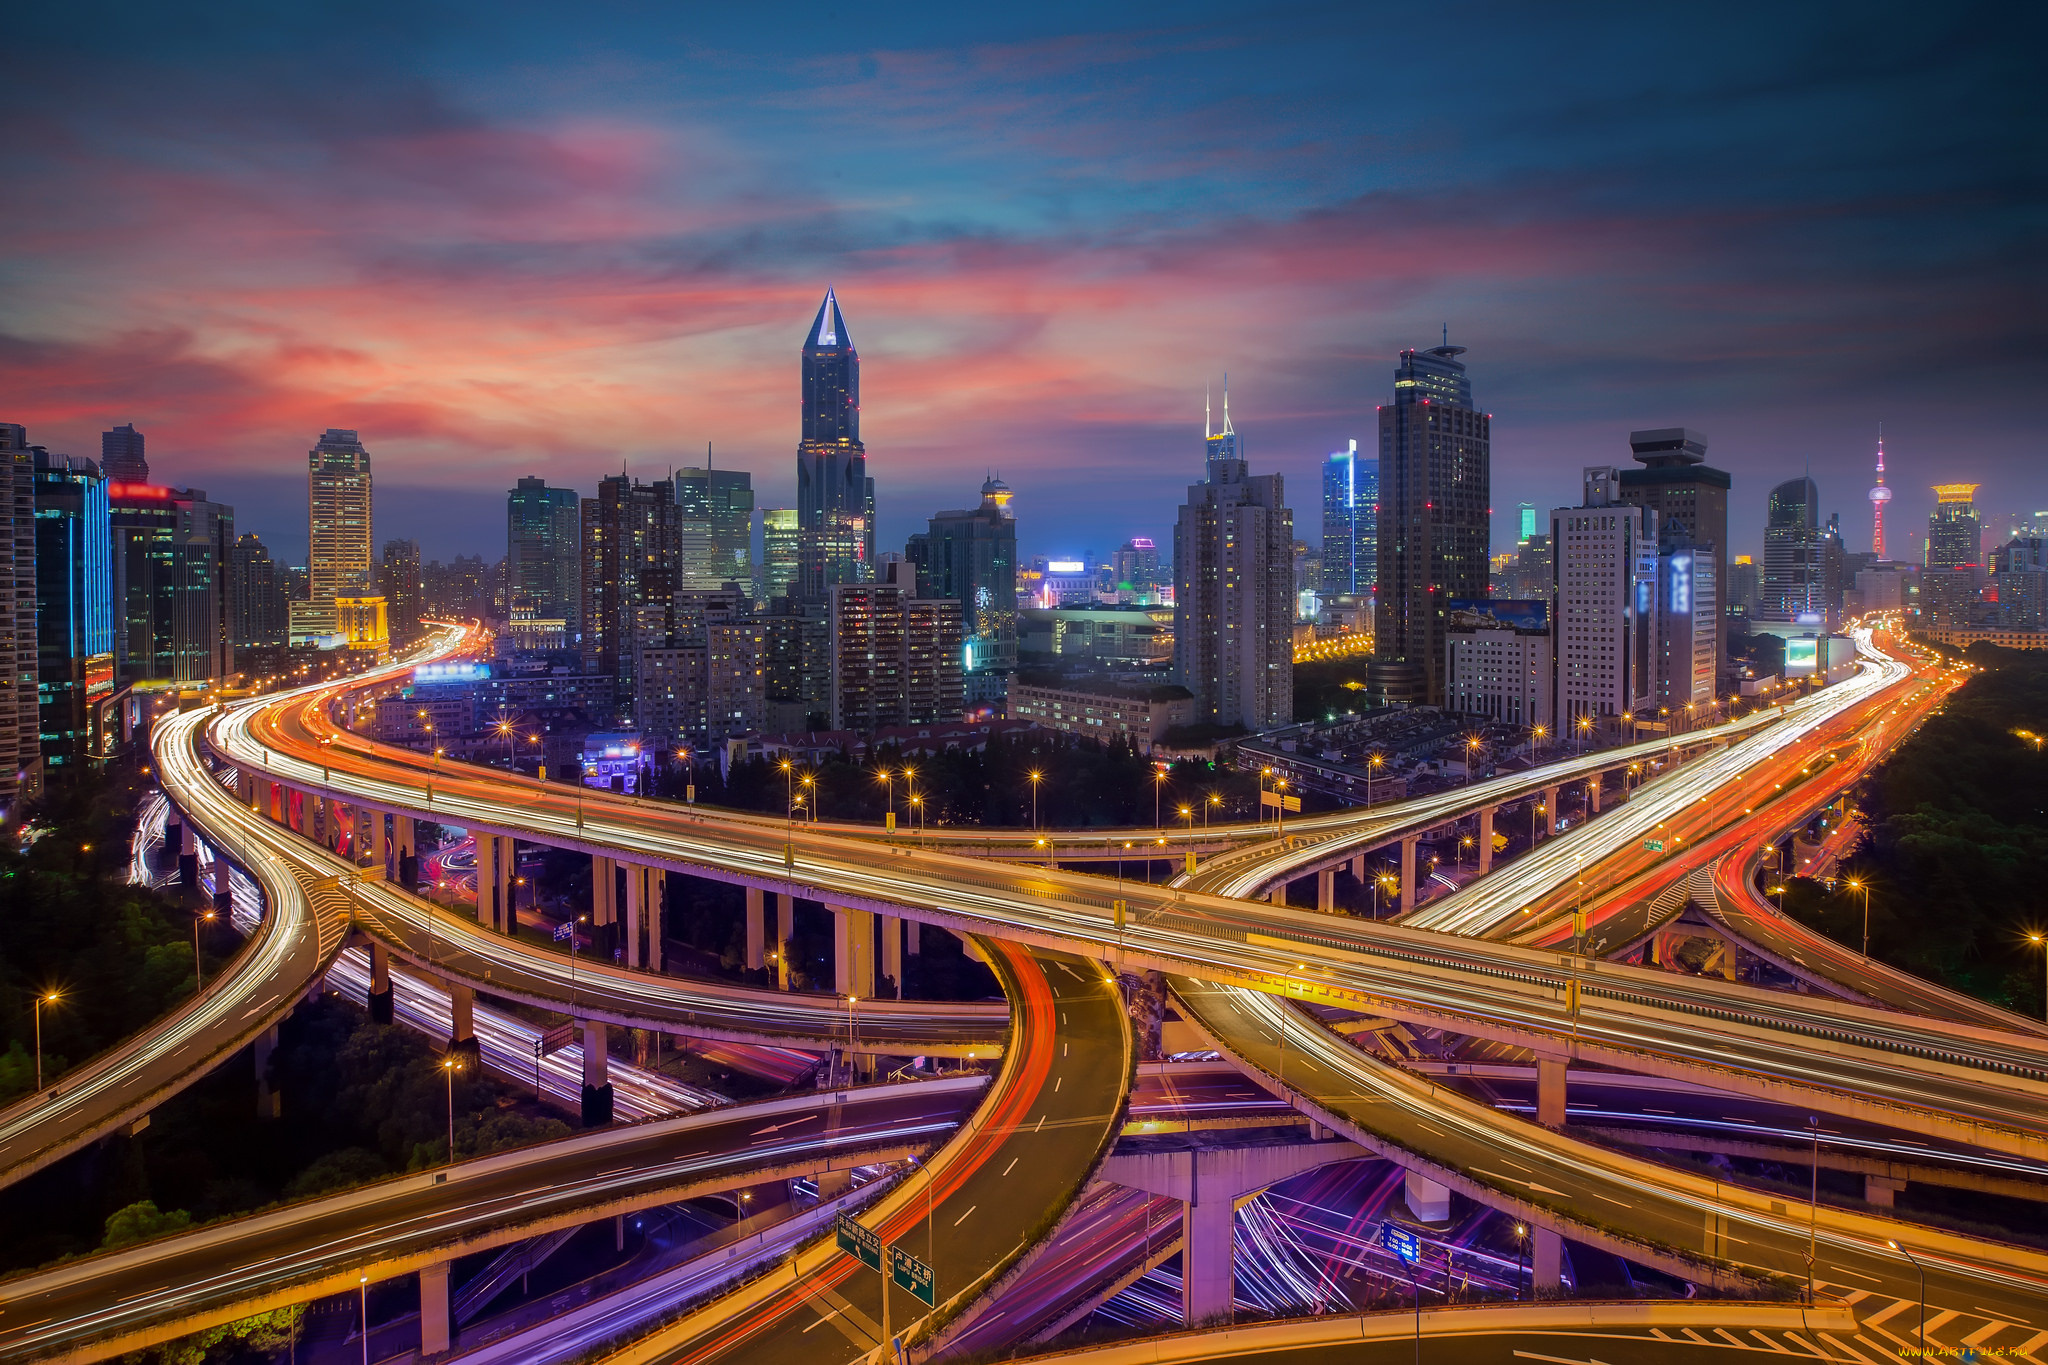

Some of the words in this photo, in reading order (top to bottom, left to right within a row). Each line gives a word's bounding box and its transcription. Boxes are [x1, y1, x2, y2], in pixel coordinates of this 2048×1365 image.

[839, 1215, 879, 1249] 共和新路立交
[895, 1251, 931, 1282] 卢浦大桥
[898, 1262, 910, 1275] LUPU
[911, 1271, 928, 1288] BRIDGE
